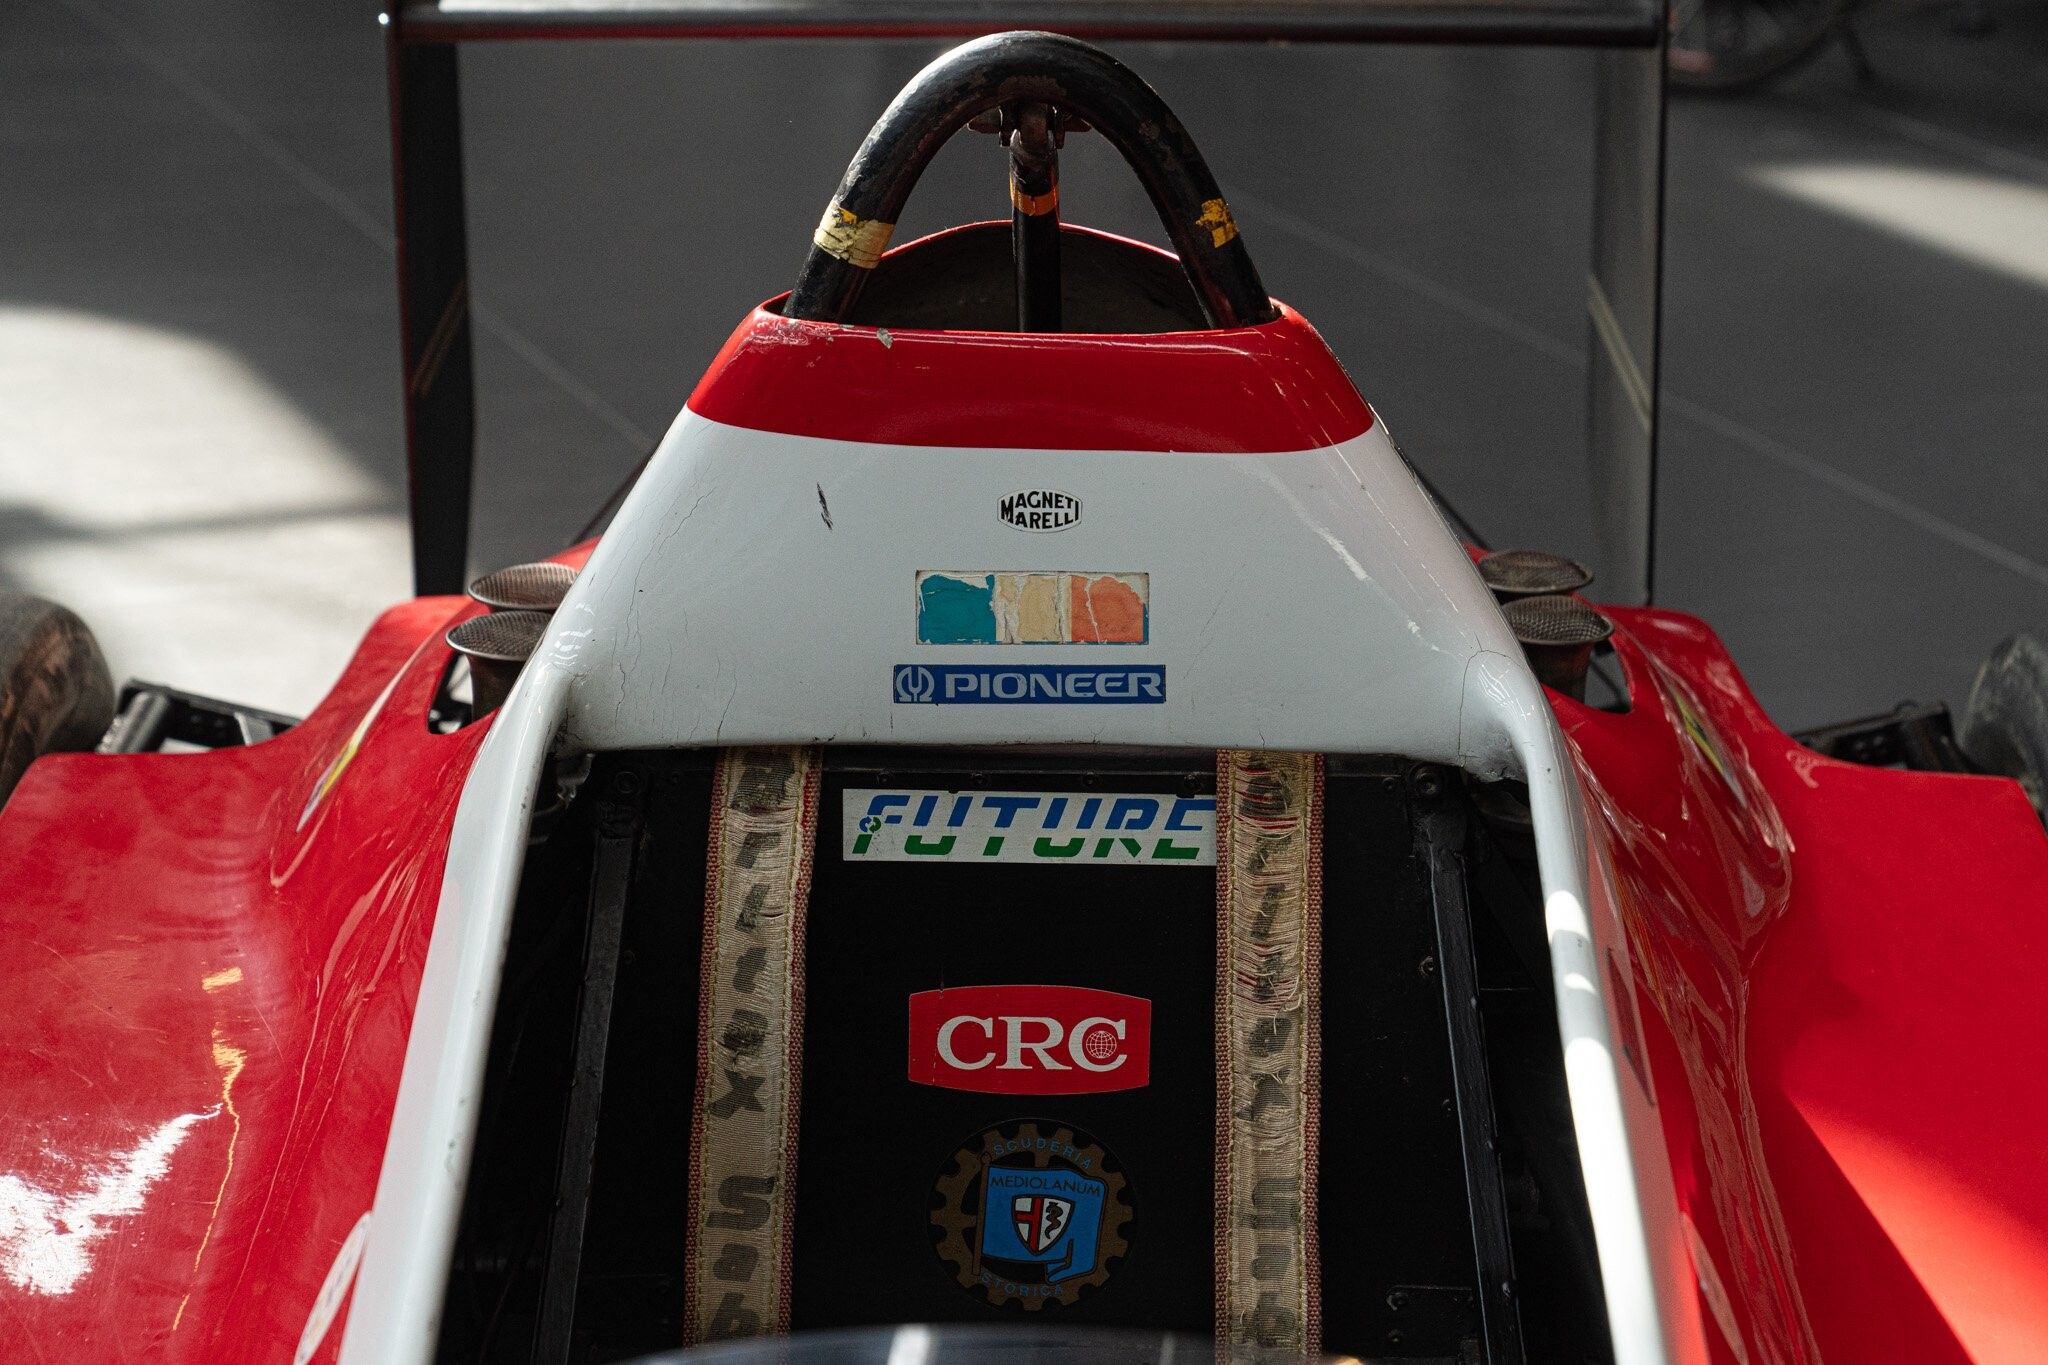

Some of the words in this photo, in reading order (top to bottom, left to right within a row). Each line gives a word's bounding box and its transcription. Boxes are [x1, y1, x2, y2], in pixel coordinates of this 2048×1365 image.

[1001, 491, 1079, 523] MAGNETI
[1001, 496, 1079, 529] MARELLI
[945, 672, 1164, 699] PIONEER
[851, 794, 1216, 860] FUTURE
[936, 1014, 1128, 1073] CRC
[993, 1136, 1093, 1170] SCUDERIA
[990, 1174, 1100, 1197] MEDIOLANUM
[980, 1270, 1065, 1298] STORICA
